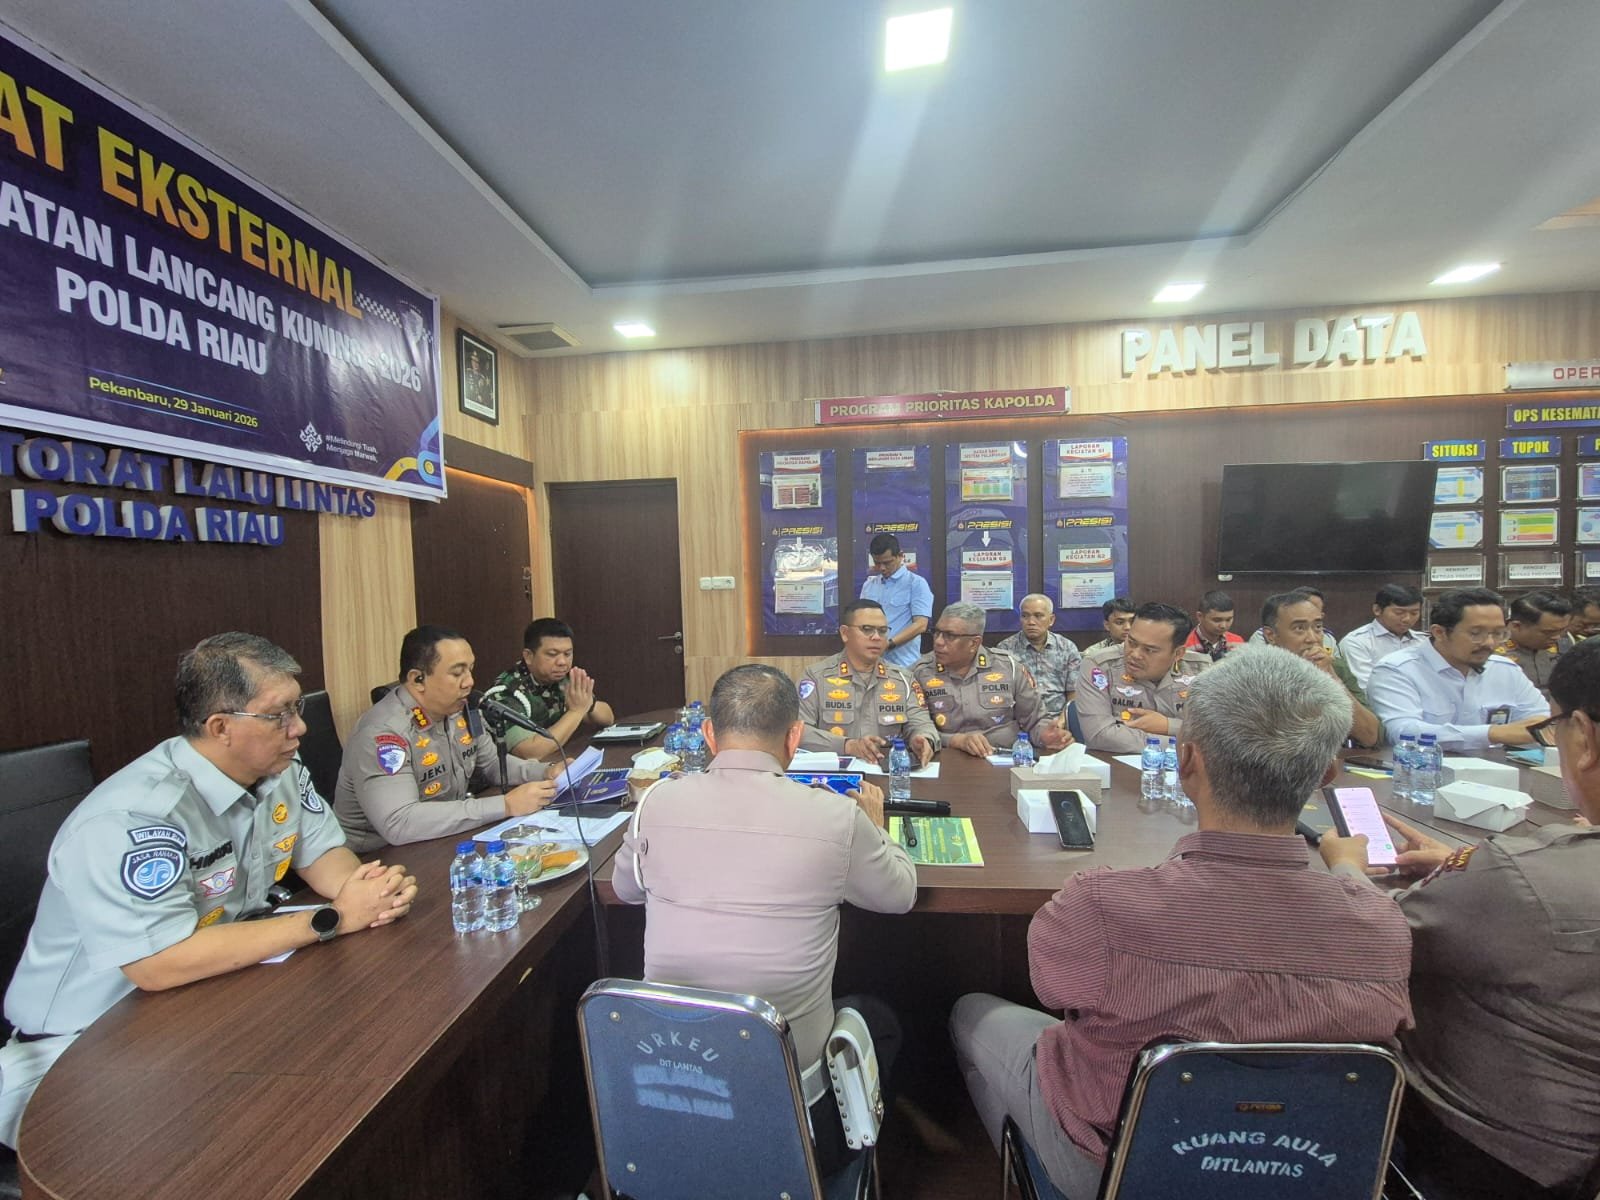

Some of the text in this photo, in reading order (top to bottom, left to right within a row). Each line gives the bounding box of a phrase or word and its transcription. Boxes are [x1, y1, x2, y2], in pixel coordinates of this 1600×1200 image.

[0, 71, 361, 318] AT EKSTERNAL
[0, 181, 114, 268] ATAN
[125, 234, 276, 333] LANCANG
[281, 306, 362, 367] KUNING
[379, 353, 422, 392] 2026
[56, 267, 268, 375] POLDA RIAU
[1123, 311, 1427, 377] PANEL DATA
[89, 376, 259, 428] Pekanbaru, 29 Januari 2026
[829, 394, 1056, 417] PROGRAM PRIORITAS KAPOLDA
[1513, 408, 1539, 422] OPS
[1431, 443, 1478, 457] SITUASI
[1512, 440, 1550, 454] TUPOK
[0, 431, 376, 518] TORAT LALU LINTAS
[12, 489, 285, 545] POLDA RIAU
[981, 683, 1009, 693] POLRI
[878, 704, 904, 713] POLRI
[420, 764, 446, 783] JEKI
[132, 852, 151, 864] JASA
[636, 1031, 719, 1062] URKEU
[659, 1058, 672, 1069] DIT
[1172, 1131, 1337, 1168] RUANG AULA
[1201, 1155, 1304, 1178] DITLANTAS
